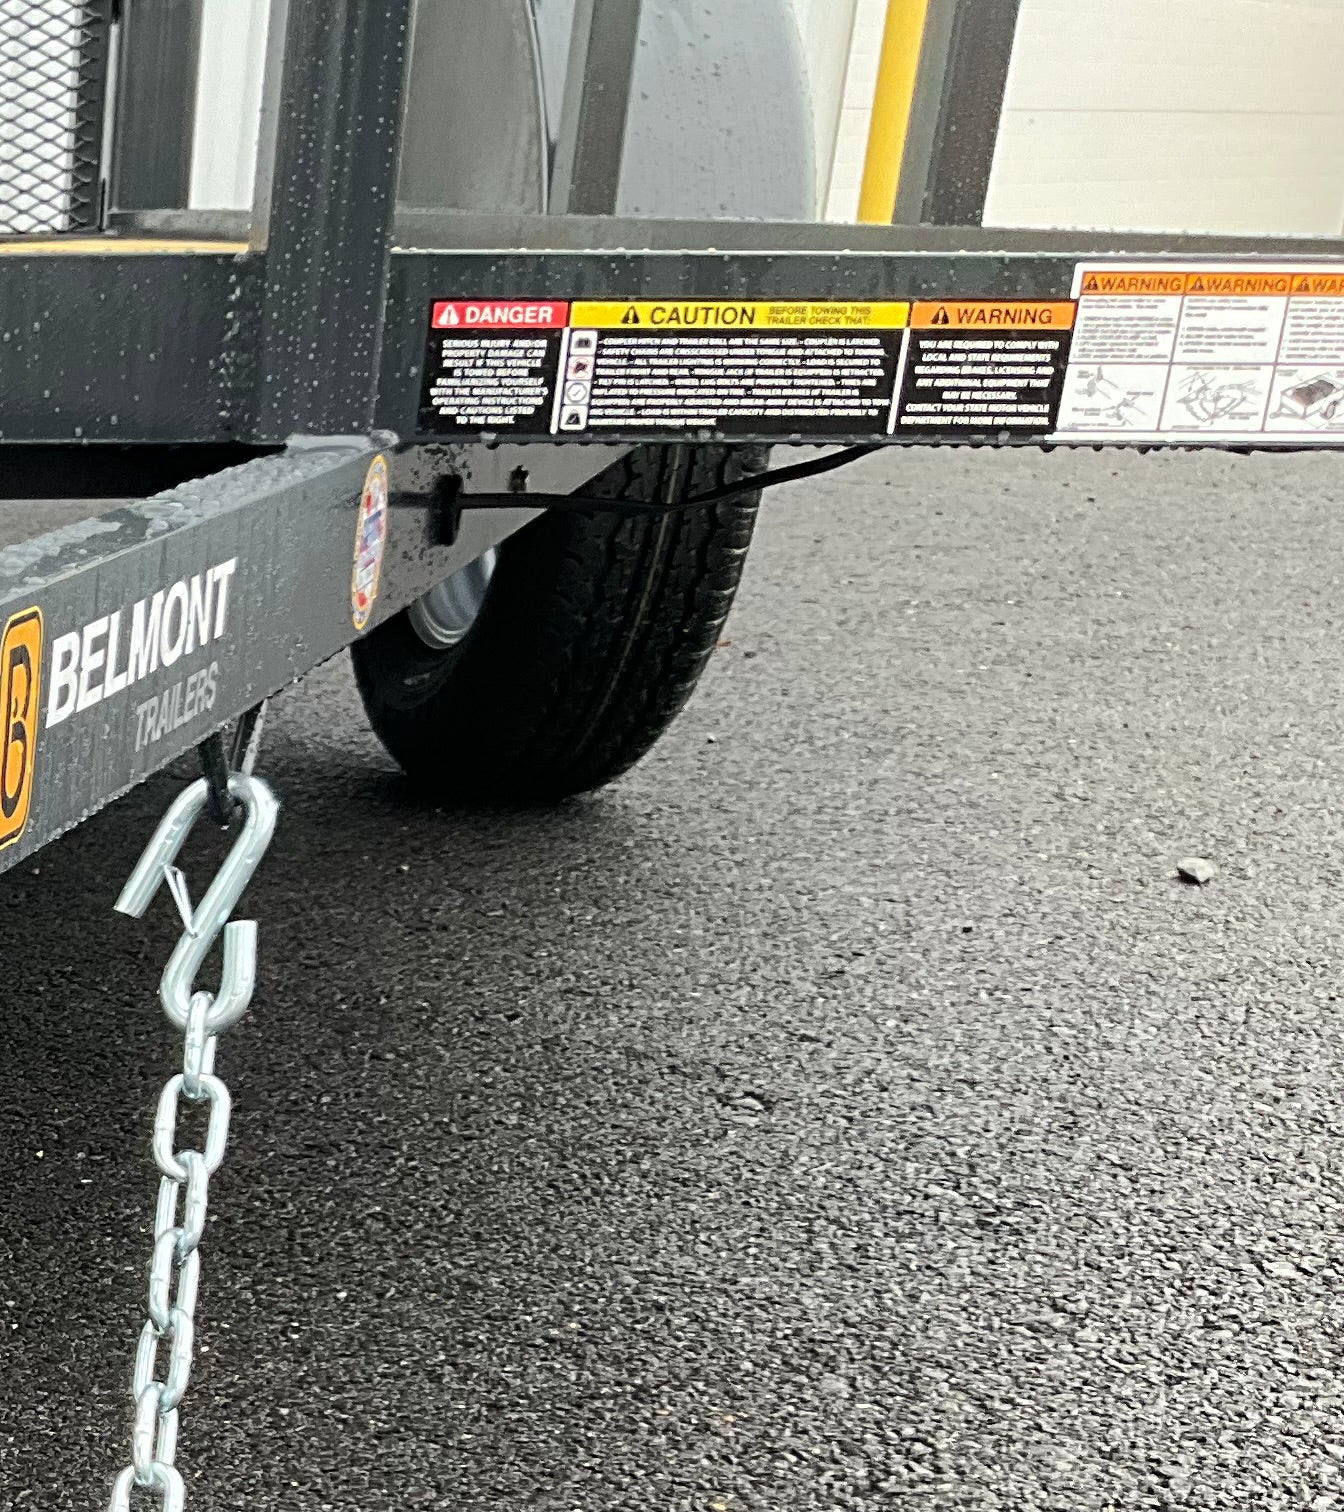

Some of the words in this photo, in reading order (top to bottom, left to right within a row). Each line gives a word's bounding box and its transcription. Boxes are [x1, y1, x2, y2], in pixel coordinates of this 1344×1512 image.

[1101, 277, 1182, 292] WARNING
[1207, 278, 1288, 292] WARNING
[465, 305, 554, 324] DANGER
[650, 306, 756, 325] CAUTION
[768, 306, 808, 315] BEFORE
[811, 306, 848, 315] TOWING
[851, 306, 872, 315] THIS
[956, 307, 1053, 325] WARNING
[766, 315, 807, 325] TRAILER
[809, 315, 842, 325] CHECK
[44, 556, 239, 730] BELMONT
[134, 660, 219, 753] TRAILERS
